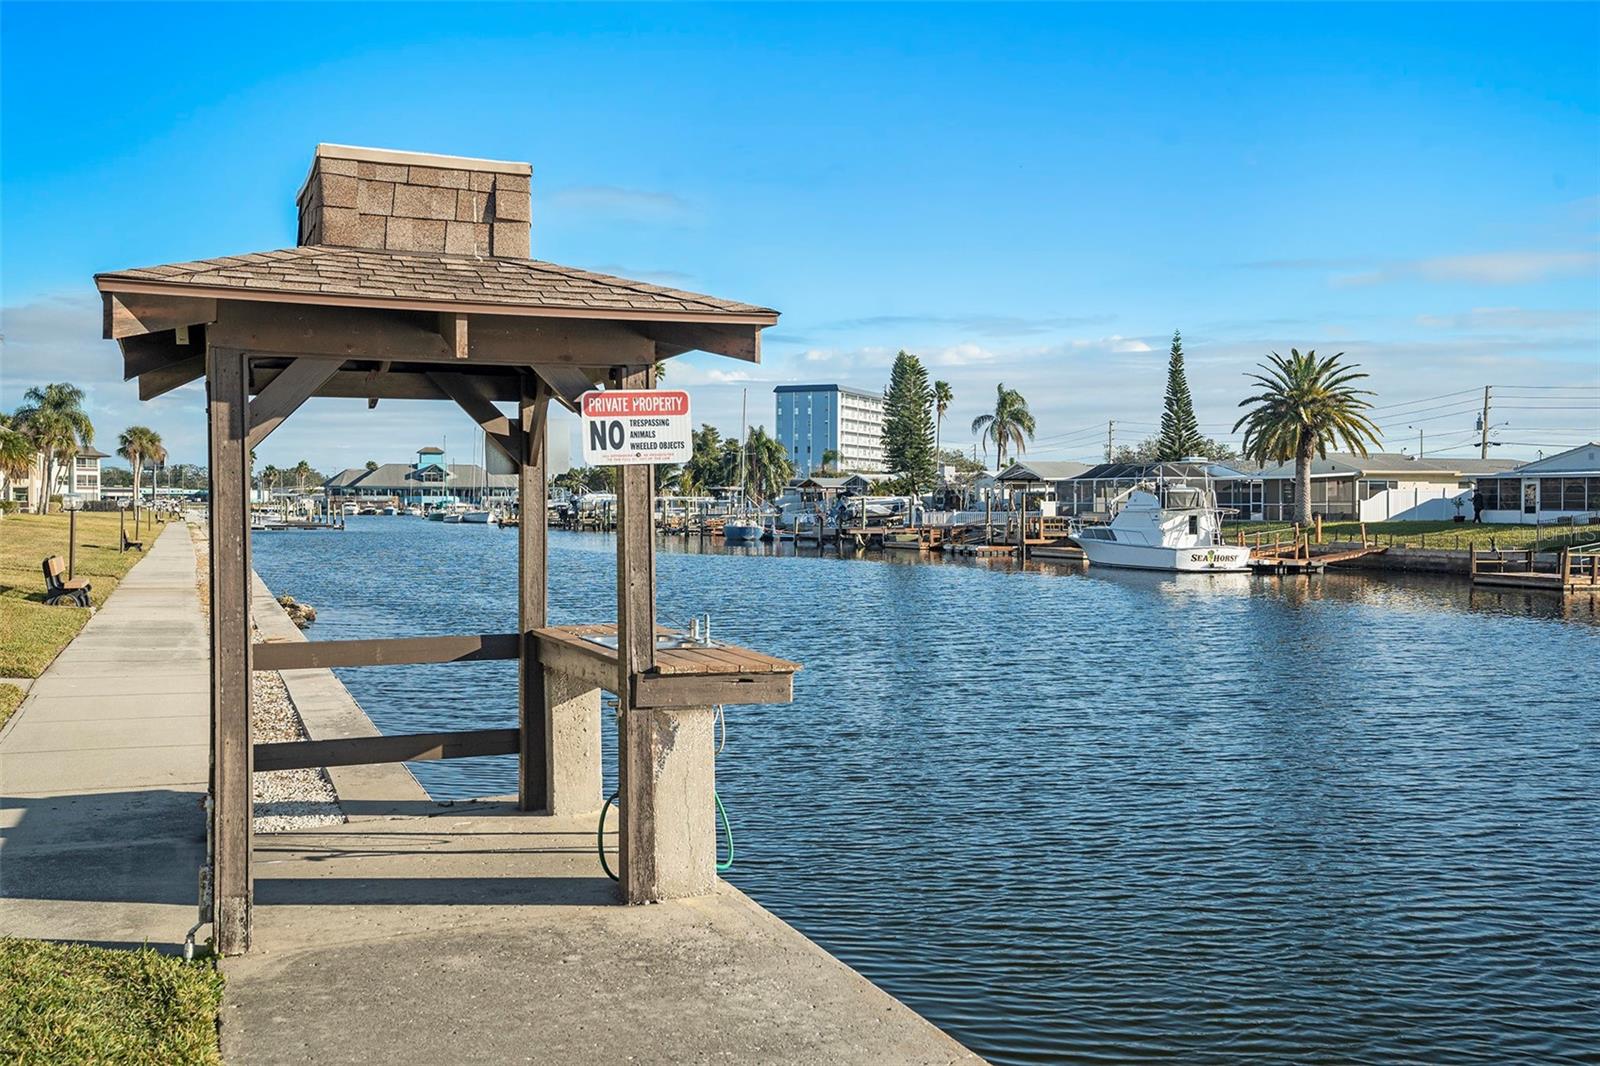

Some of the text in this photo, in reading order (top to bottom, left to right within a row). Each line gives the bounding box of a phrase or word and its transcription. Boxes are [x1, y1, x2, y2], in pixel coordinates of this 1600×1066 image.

[589, 397, 683, 412] PRIVATE PROPERTY
[630, 419, 670, 427] TRESPASSING
[590, 420, 625, 451] NO
[630, 430, 656, 438] ANIMALS
[630, 441, 685, 450] WHEELED OBJECTS
[1190, 554, 1208, 562] SEA
